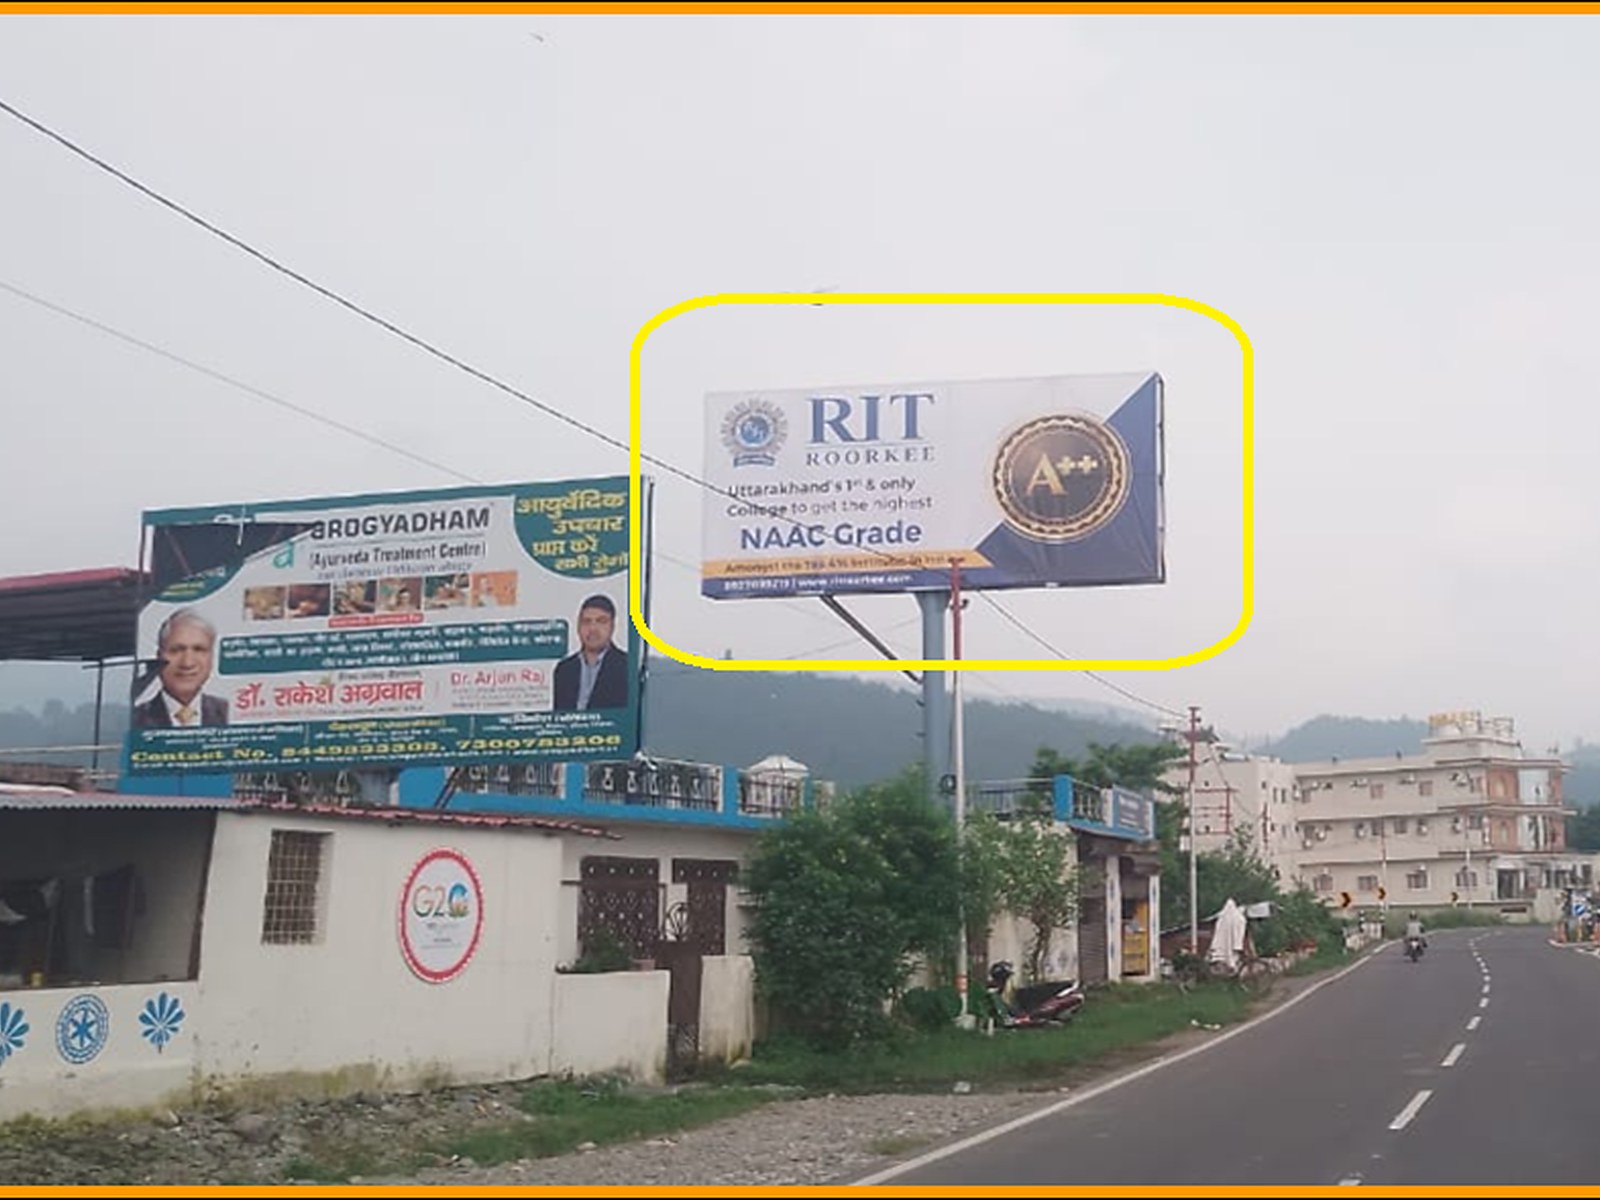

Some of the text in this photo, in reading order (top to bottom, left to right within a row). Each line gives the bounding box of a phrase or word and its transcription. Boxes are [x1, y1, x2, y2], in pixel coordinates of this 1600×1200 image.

[807, 393, 935, 444] RIT
[806, 446, 936, 467] ROORKEE
[866, 478, 876, 491] &
[880, 476, 916, 493] only
[1025, 452, 1098, 496] A++
[726, 495, 933, 518] College to get the highest
[741, 520, 923, 550] NAAC Grade
[374, 547, 436, 562] Treatment
[451, 667, 546, 687] Dr. Arjun Raj
[236, 680, 424, 709] डॉ. राकेश अग्रवाल
[131, 749, 224, 763] Contact
[232, 747, 273, 760] No.
